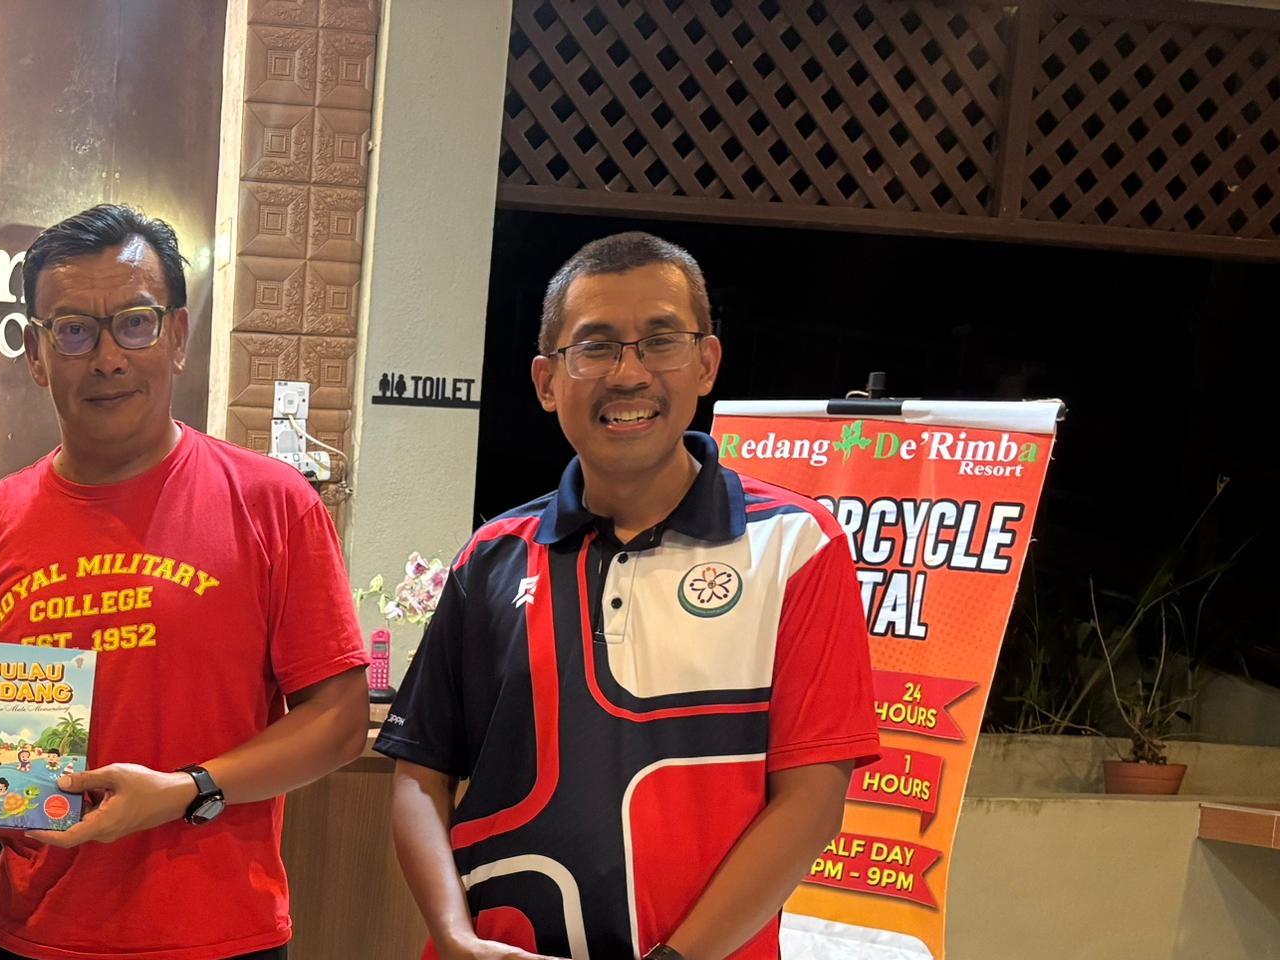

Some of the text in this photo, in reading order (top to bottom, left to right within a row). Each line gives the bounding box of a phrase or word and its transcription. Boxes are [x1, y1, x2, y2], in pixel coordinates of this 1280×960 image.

[411, 375, 475, 401] TOILET
[720, 431, 1038, 465] Redang De'Rimba
[958, 461, 1023, 477] Resort
[816, 496, 1023, 572] RCYCLE
[75, 553, 221, 596] MILITARY
[29, 585, 154, 623] COLLEGE
[856, 569, 927, 638] TAL
[91, 623, 156, 652] 1952
[903, 682, 921, 702] 24
[874, 701, 937, 728] HOURS
[862, 772, 930, 801] HOURS
[824, 838, 914, 866] ALF DAY
[811, 858, 844, 880] PM
[866, 867, 914, 892] 9PM
